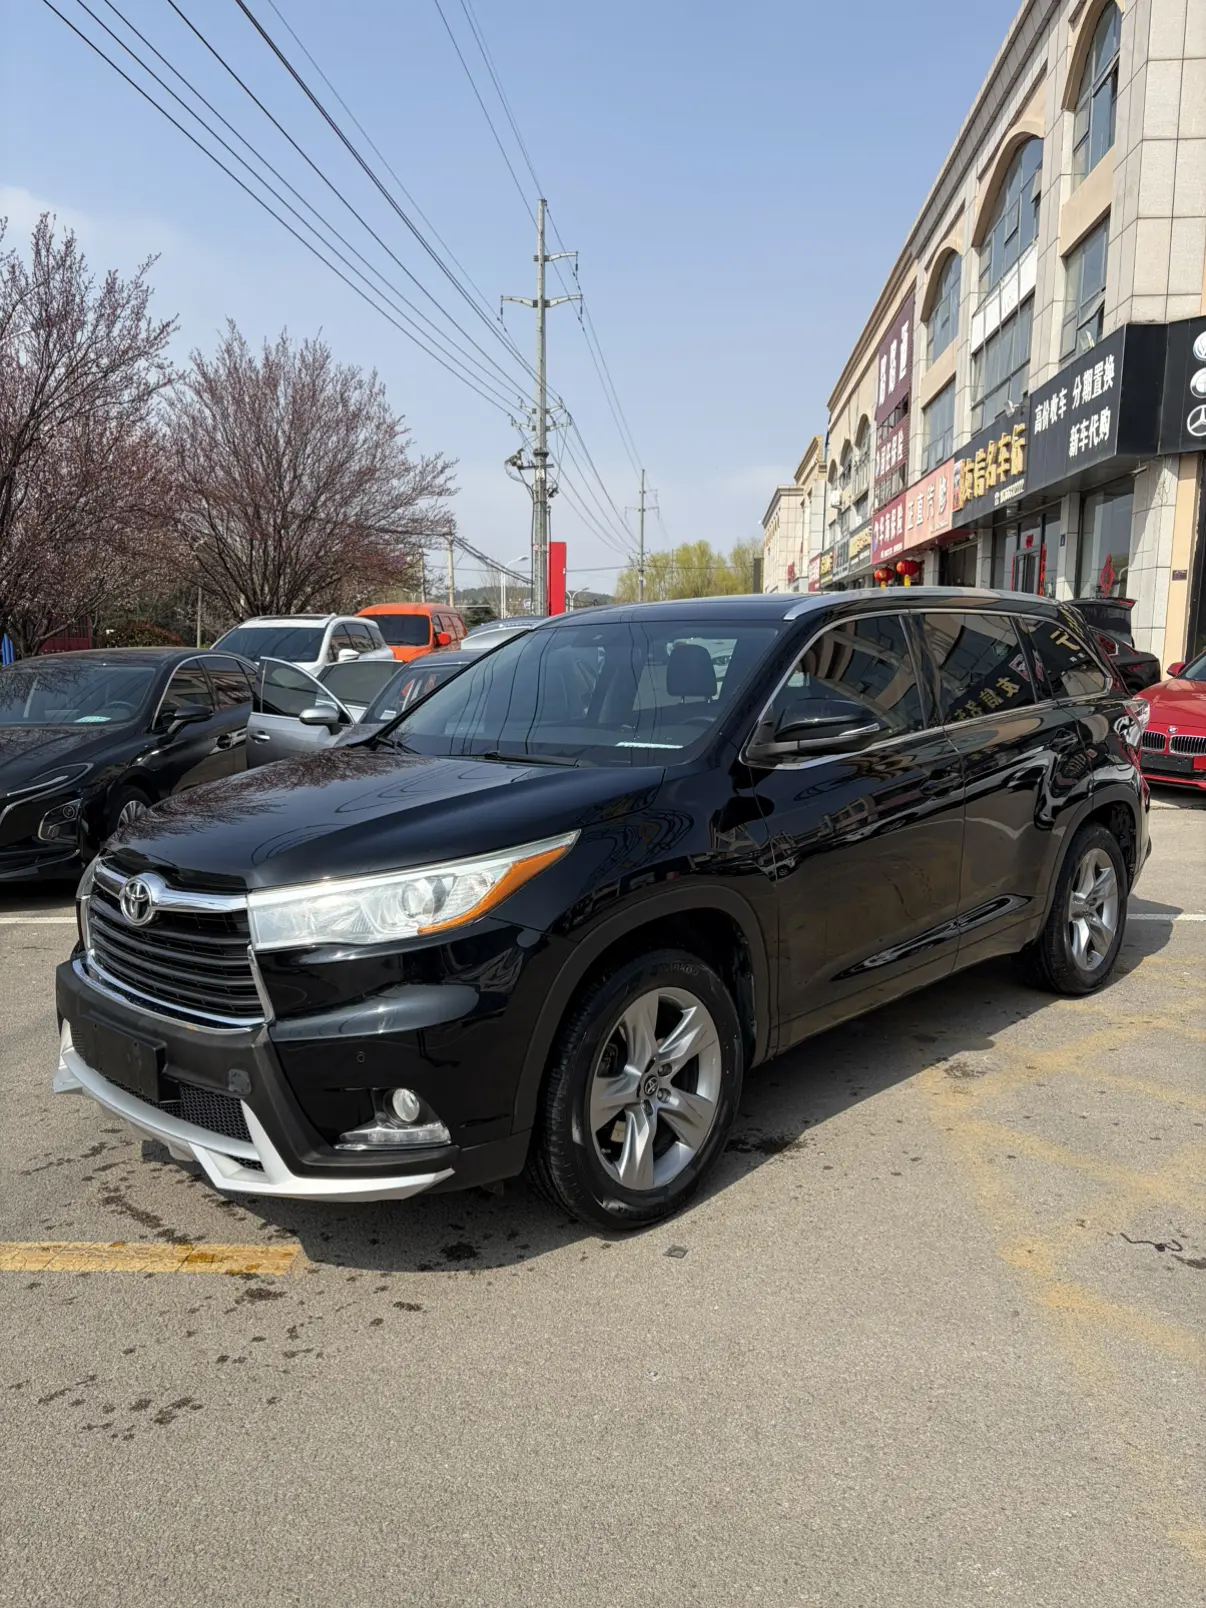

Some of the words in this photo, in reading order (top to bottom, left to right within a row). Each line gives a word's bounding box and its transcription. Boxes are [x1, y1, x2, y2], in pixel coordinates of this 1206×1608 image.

[1034, 387, 1068, 435] 高价收车
[1072, 354, 1115, 409] 分期置换
[1069, 406, 1111, 457] 新车代购
[963, 423, 1026, 500] 友信名车行
